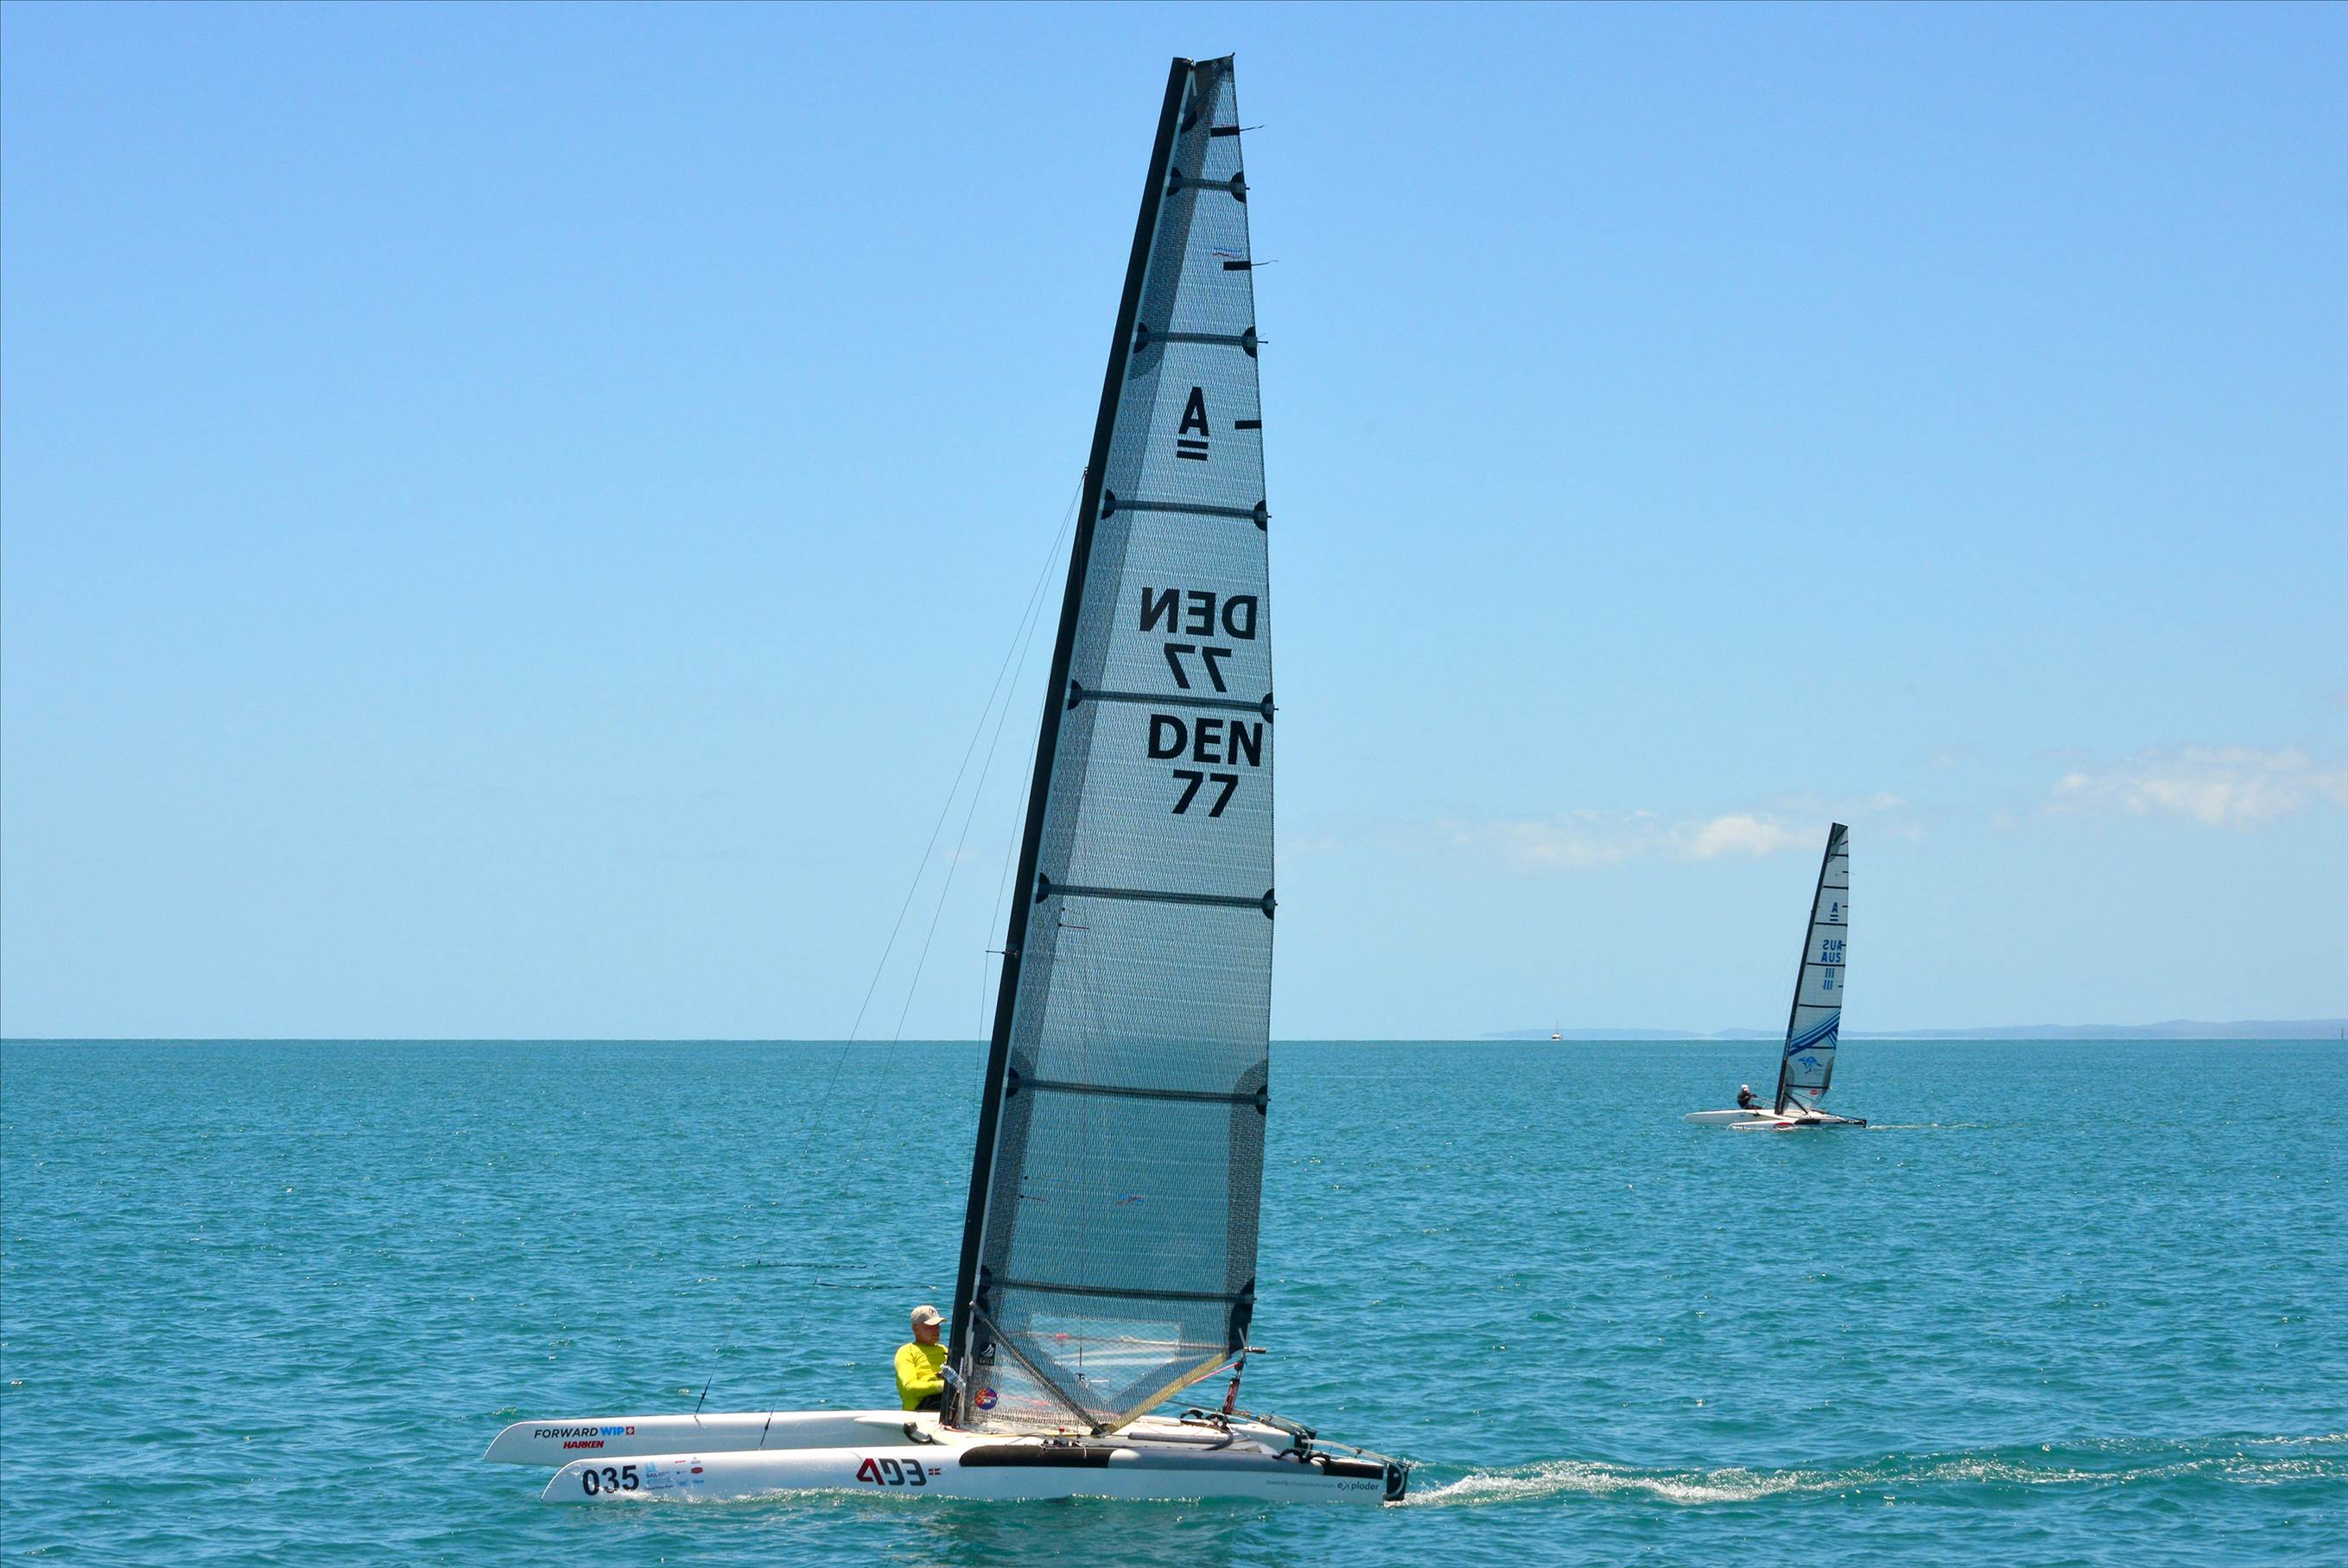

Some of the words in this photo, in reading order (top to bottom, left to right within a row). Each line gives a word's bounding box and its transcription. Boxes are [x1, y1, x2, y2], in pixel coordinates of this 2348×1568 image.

[1178, 386, 1209, 436] A
[1147, 714, 1264, 767] DEN
[1171, 769, 1239, 818] 77
[1821, 951, 1842, 963] AUS
[534, 1427, 599, 1438] FORWARD
[600, 1426, 625, 1437] WIP
[563, 1440, 605, 1449] HARKEN
[582, 1464, 639, 1495] 035
